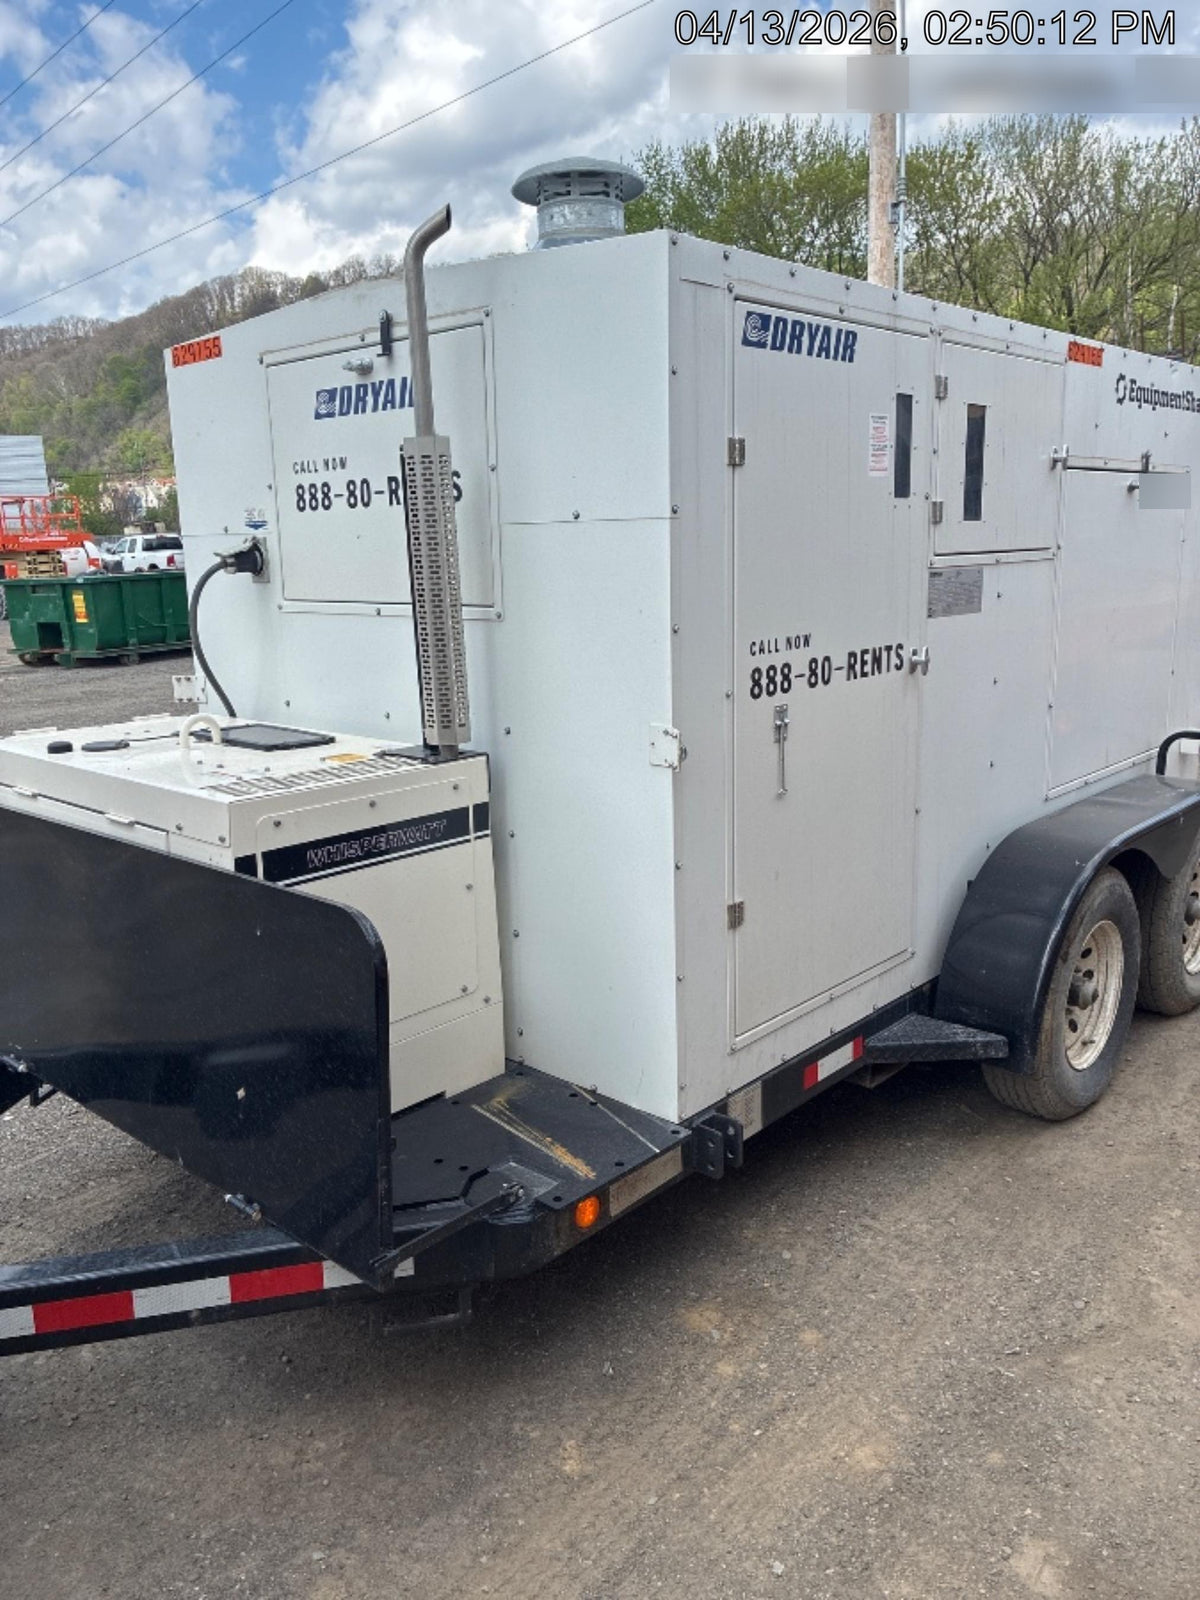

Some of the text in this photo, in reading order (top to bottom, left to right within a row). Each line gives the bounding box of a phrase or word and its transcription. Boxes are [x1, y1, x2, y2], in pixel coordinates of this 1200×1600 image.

[770, 316, 858, 363] DRYAIR
[293, 456, 347, 475] CALL NOW
[296, 470, 463, 512] 888-80-RS
[750, 633, 812, 656] CALL NOW
[750, 643, 904, 700] 888-80-RENTS
[306, 820, 447, 868] WHISPERWATT
